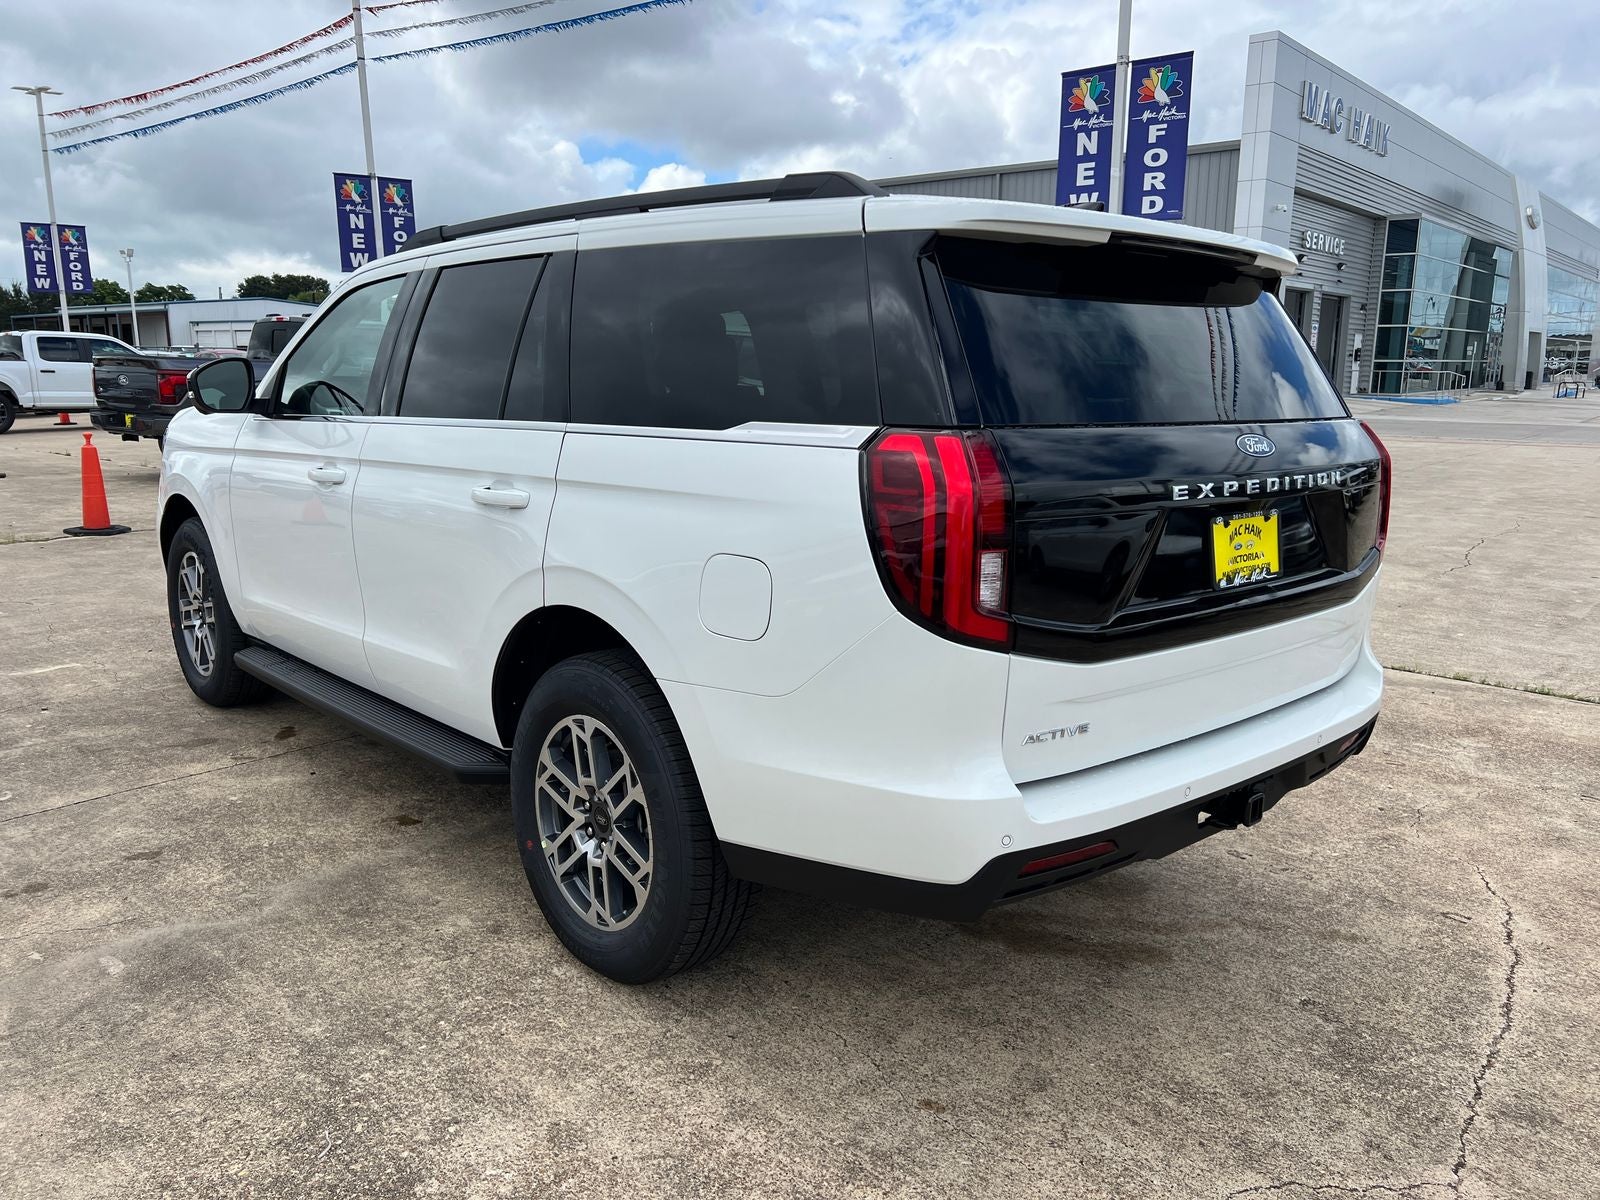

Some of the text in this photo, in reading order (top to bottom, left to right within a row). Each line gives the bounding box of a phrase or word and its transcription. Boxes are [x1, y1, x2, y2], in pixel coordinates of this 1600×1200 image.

[1162, 114, 1187, 122] VICTORIA
[1301, 80, 1391, 157] MAC HAIK
[1141, 123, 1169, 215] FORD
[349, 213, 369, 268] NEW
[1304, 230, 1346, 256] SERVICE
[33, 250, 51, 289] NEW
[69, 252, 84, 291] FORD
[1172, 471, 1342, 501] EXPEDITION
[1229, 523, 1262, 546] MAC HAIK
[1021, 721, 1090, 747] ACTIVE
